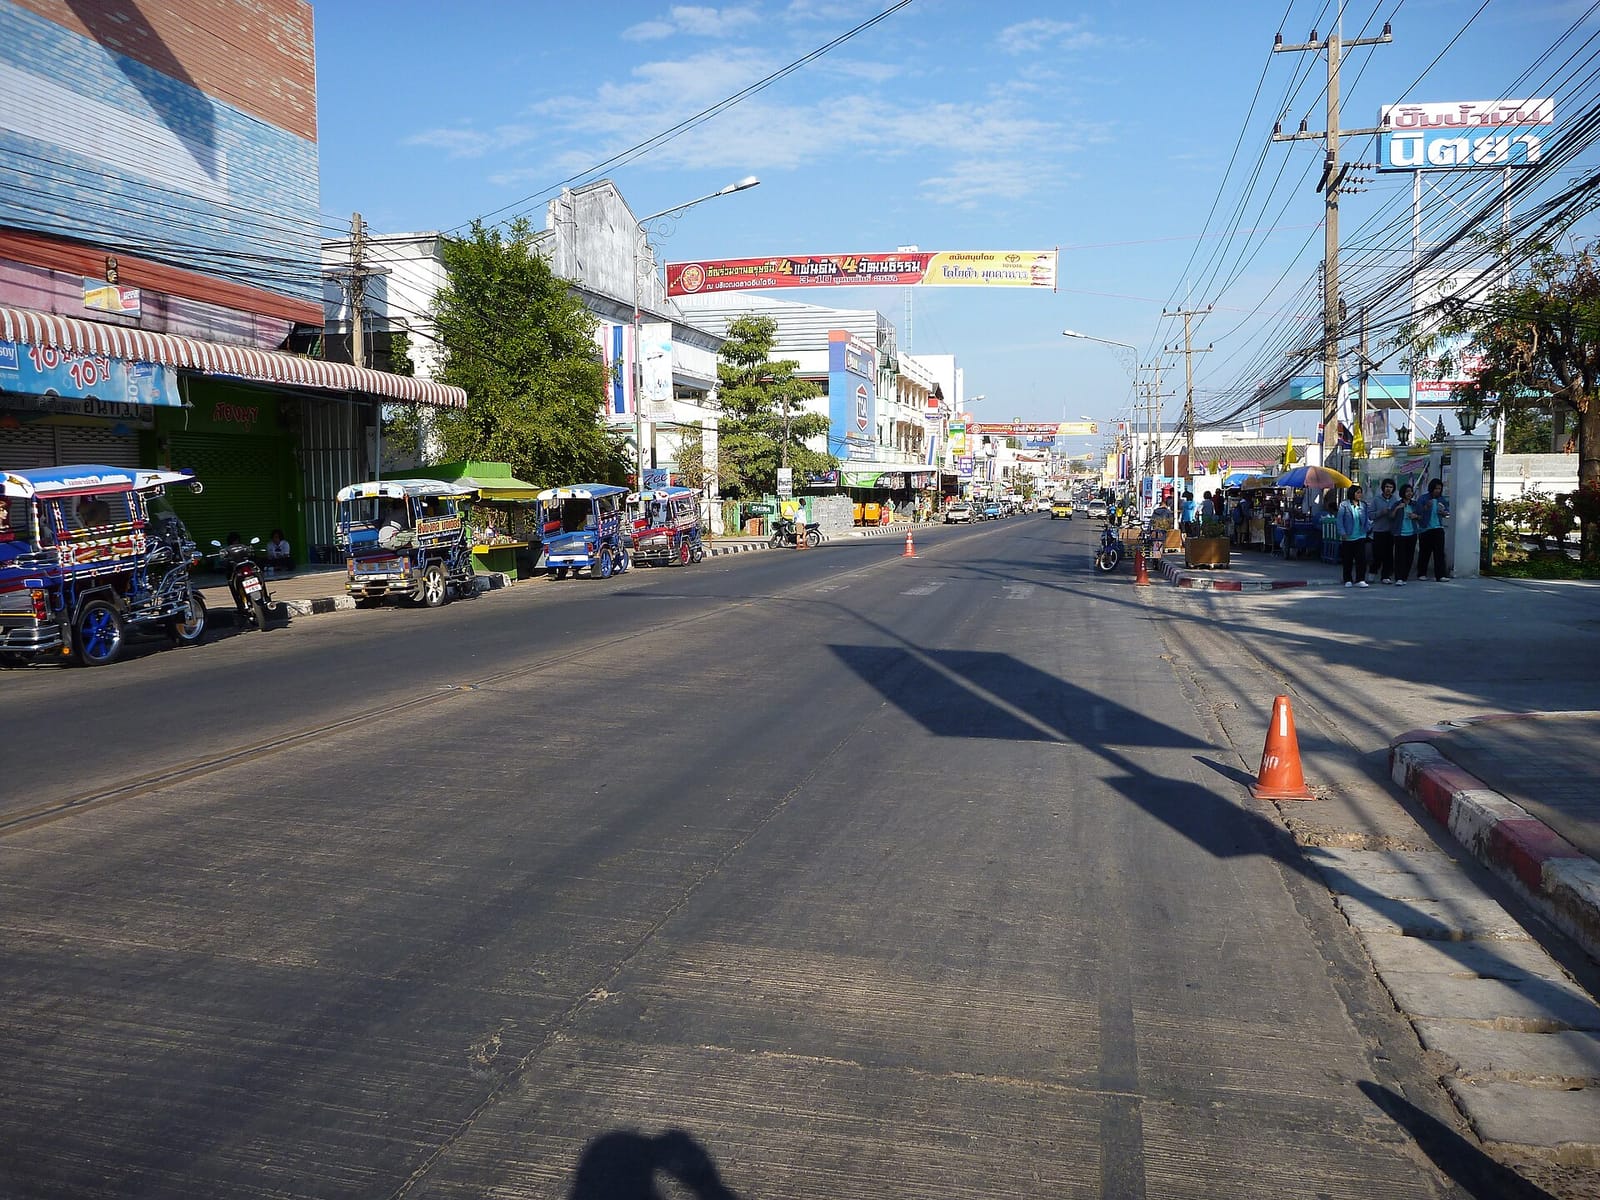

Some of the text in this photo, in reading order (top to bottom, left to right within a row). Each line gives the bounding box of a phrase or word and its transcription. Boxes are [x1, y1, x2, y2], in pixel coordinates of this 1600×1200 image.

[1395, 104, 1541, 127] ปั๊มน้ำมัน
[1390, 131, 1541, 167] นิตยา
[778, 256, 921, 275] 4 แผ่นดิน 4 วัฒนธรรม
[942, 265, 1028, 284] โตโยต้า มุกดาหาร
[29, 344, 59, 373] 10
